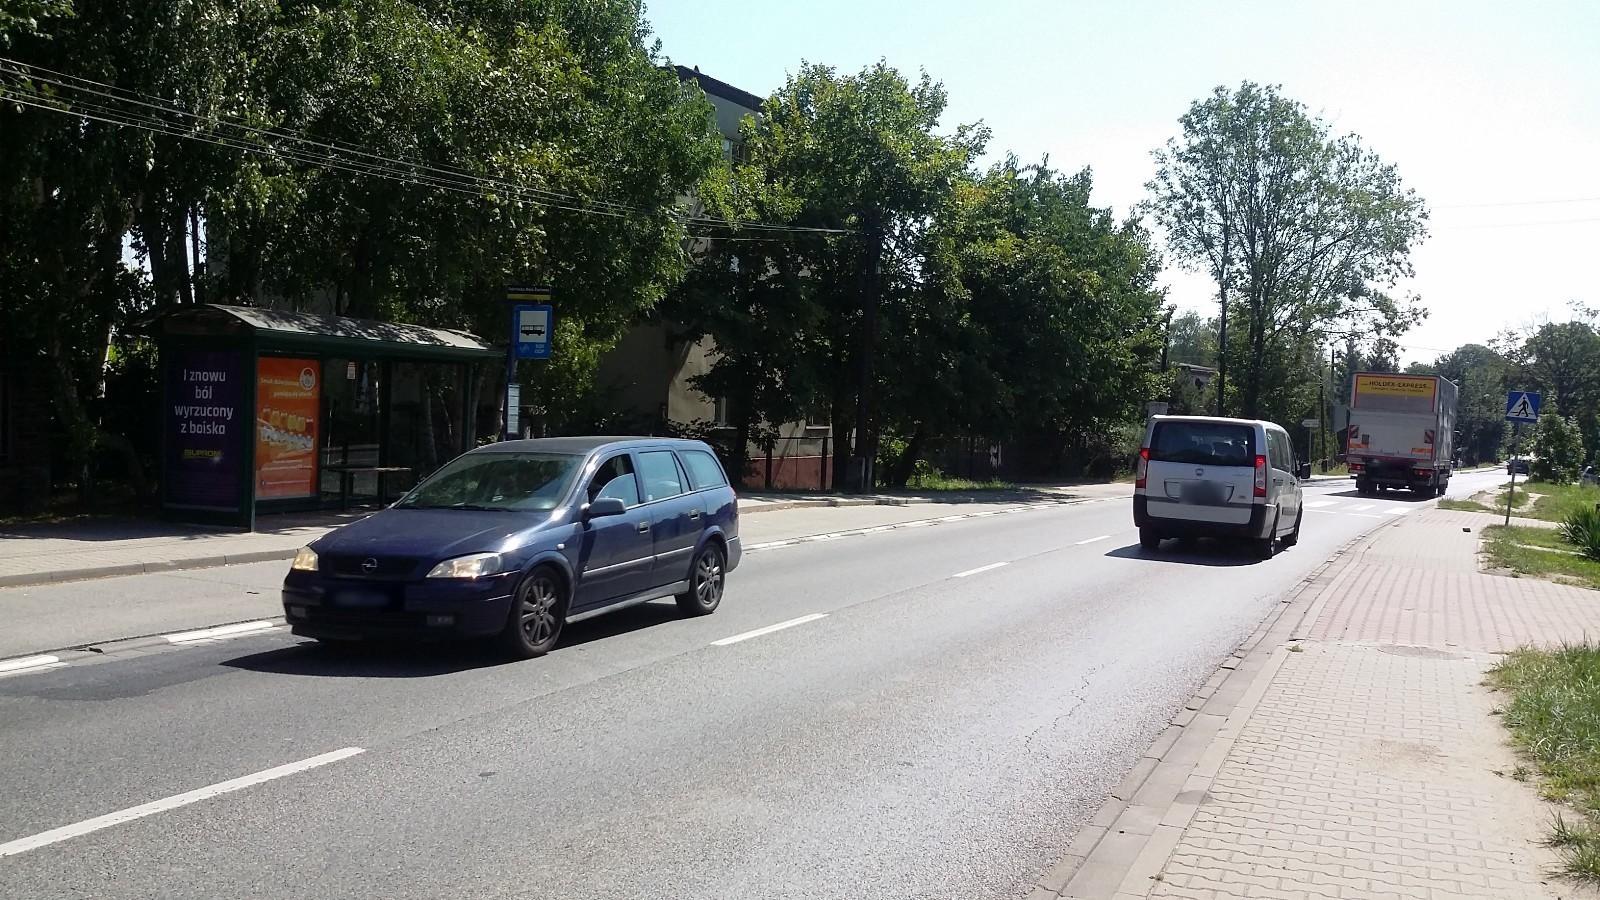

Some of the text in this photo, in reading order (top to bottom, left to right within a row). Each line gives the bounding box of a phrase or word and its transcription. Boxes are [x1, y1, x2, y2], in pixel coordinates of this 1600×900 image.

[183, 368, 226, 382] I znowu
[195, 385, 213, 399] ból
[174, 405, 234, 420] wyrzucony
[181, 423, 187, 434] z
